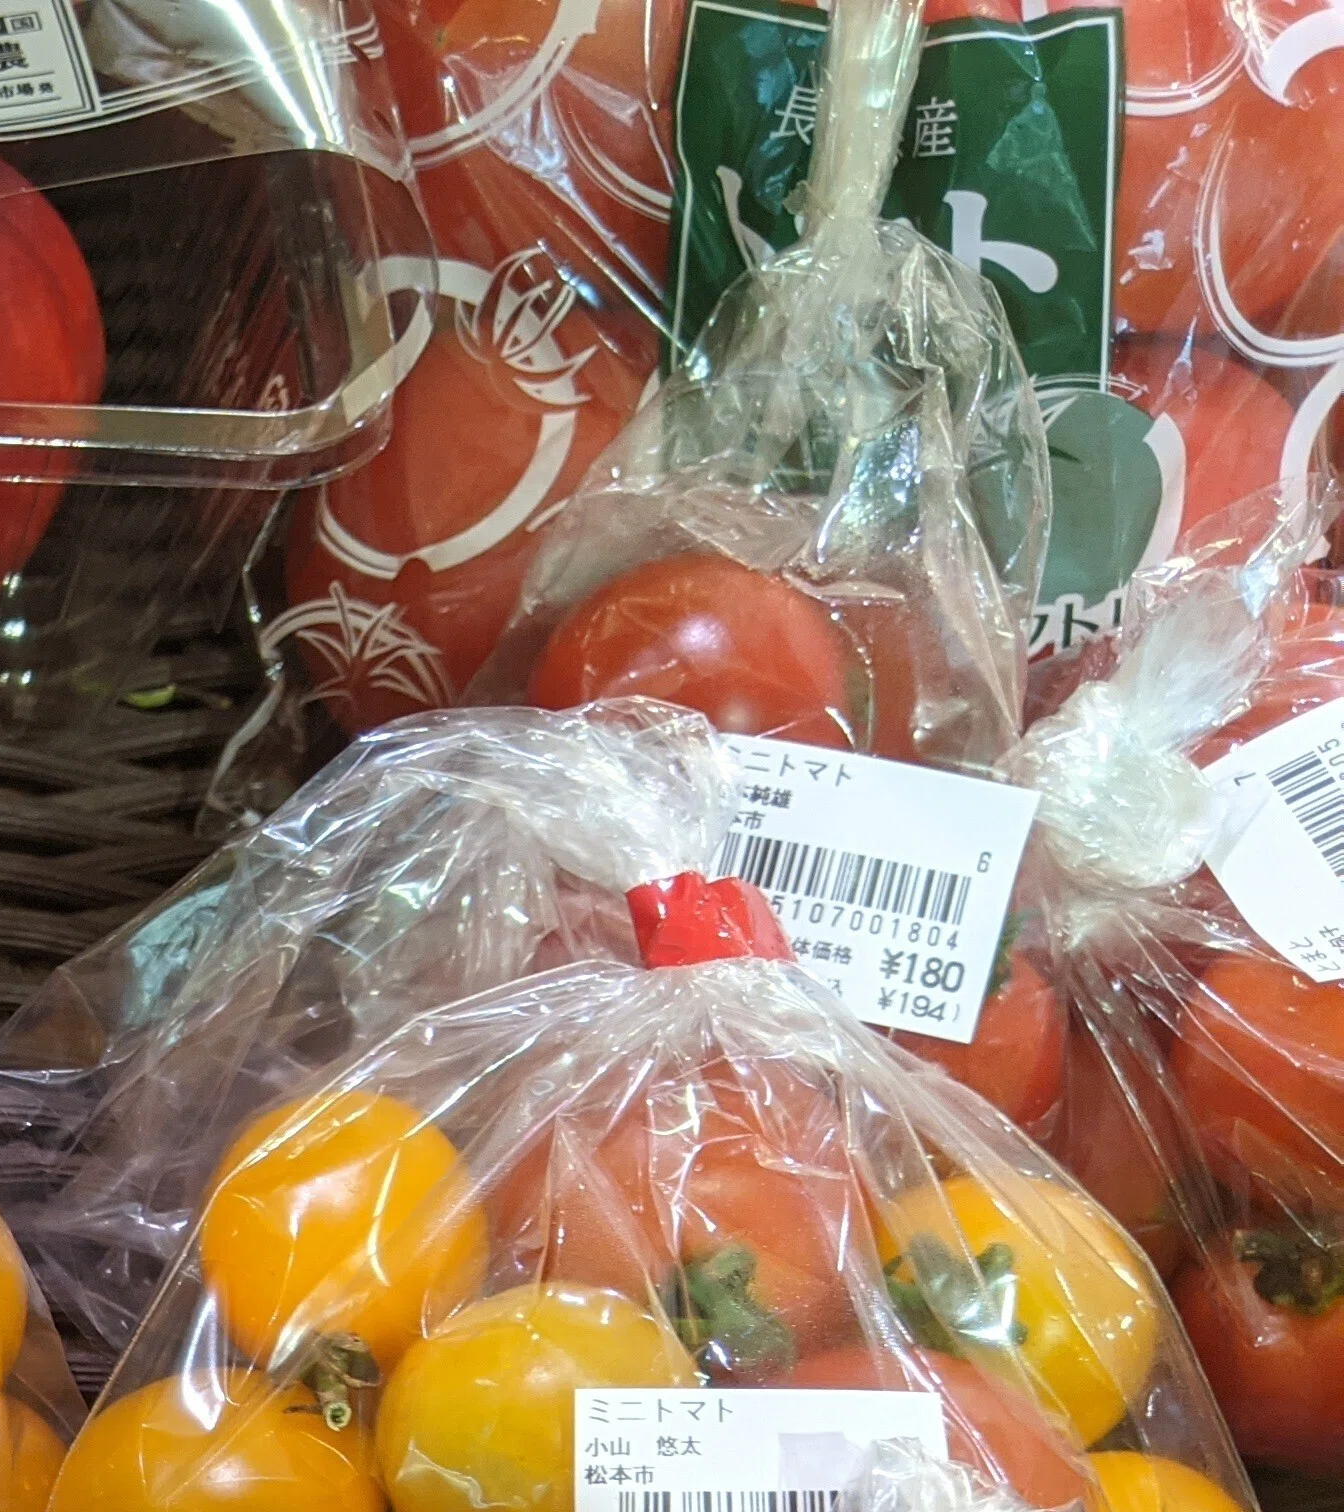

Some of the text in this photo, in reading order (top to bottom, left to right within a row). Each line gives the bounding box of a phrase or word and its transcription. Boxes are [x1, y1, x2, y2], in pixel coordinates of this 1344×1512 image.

[727, 744, 853, 788] ニトマト
[740, 783, 793, 810] 純雄
[976, 851, 993, 873] 6
[770, 896, 960, 952] 5107001804
[791, 937, 853, 966] 体価格
[879, 948, 966, 994] ¥180
[587, 1398, 734, 1424] ミニトマト
[583, 1435, 703, 1458] 小山 悠太
[583, 1464, 656, 1486] 松本市
